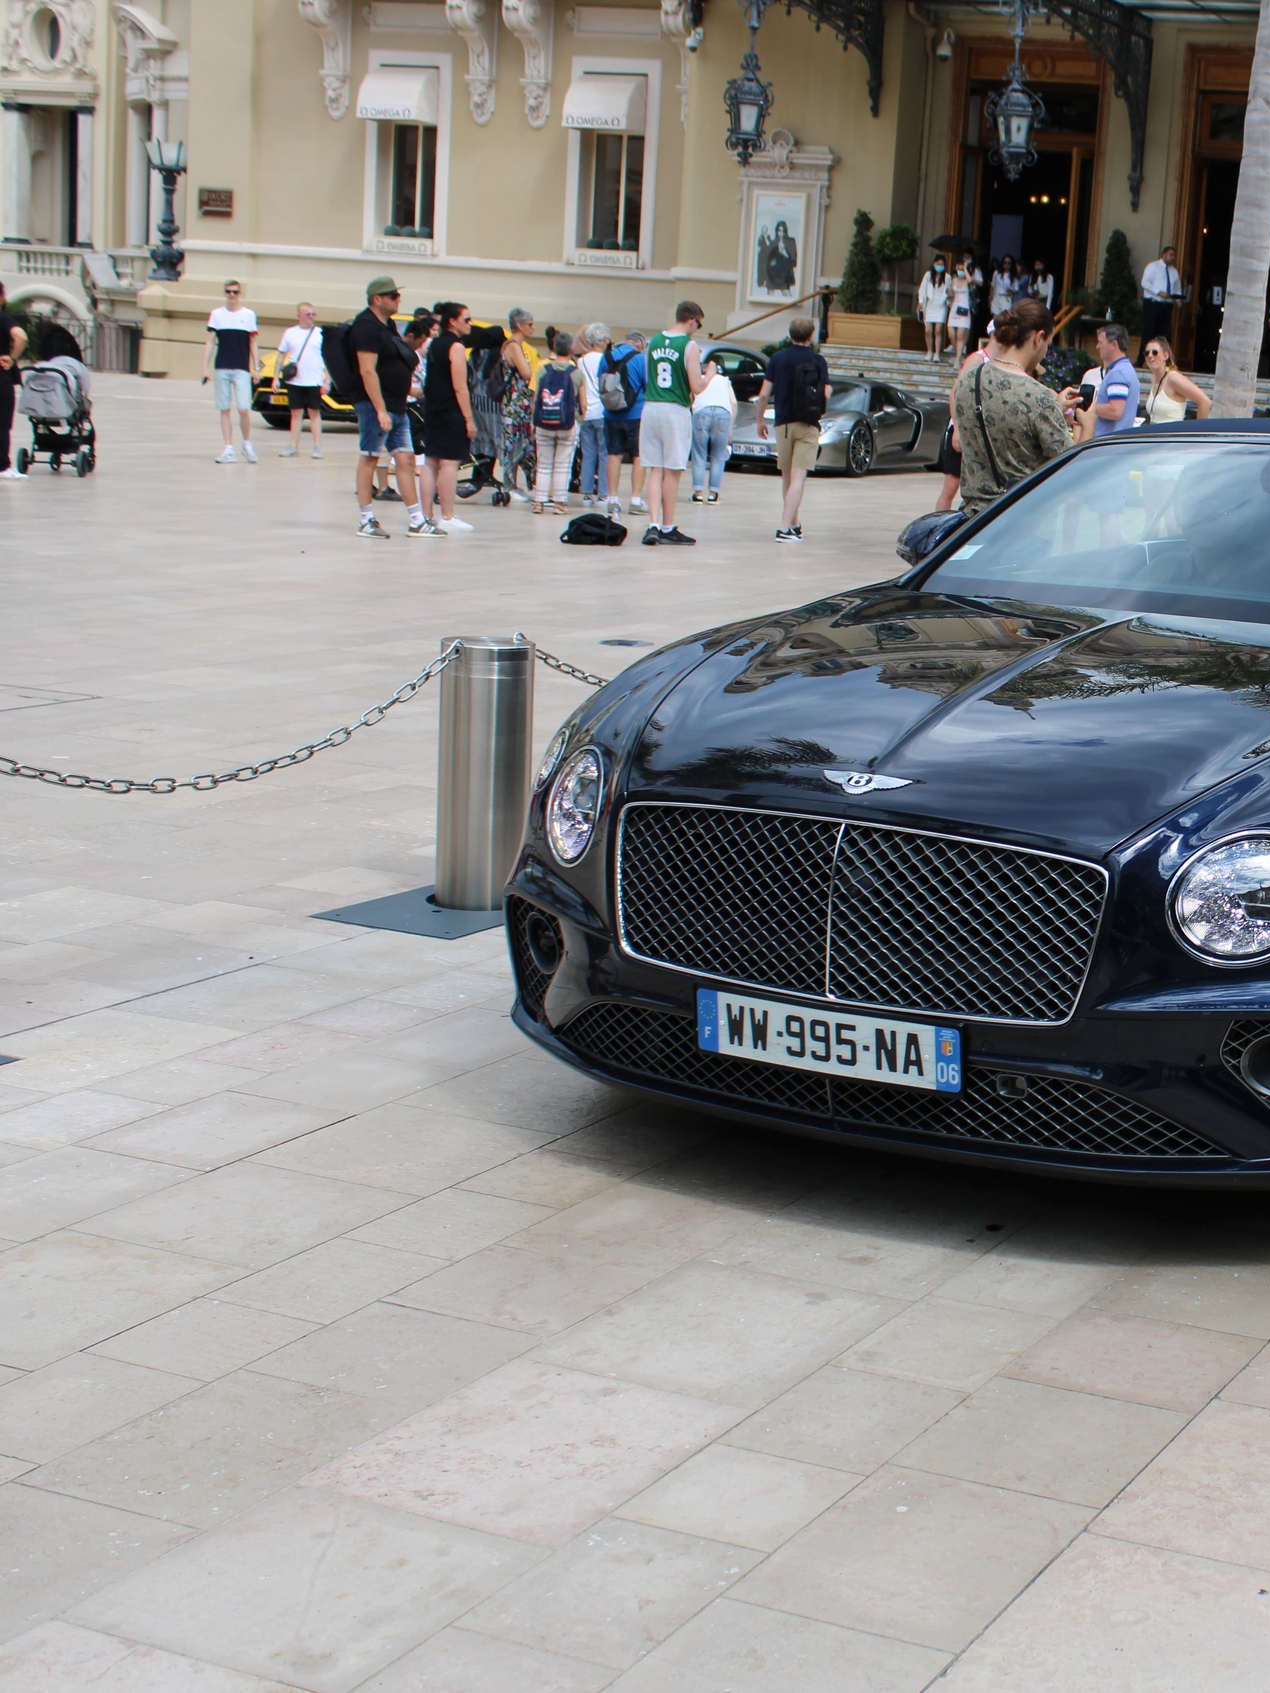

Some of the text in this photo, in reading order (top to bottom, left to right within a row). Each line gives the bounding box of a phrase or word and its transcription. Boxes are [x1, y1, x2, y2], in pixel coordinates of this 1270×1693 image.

[369, 107, 400, 118] OMEGA
[575, 116, 609, 126] OMEGA
[657, 361, 672, 389] 8
[704, 1026, 713, 1039] F
[937, 1061, 960, 1085] 06
